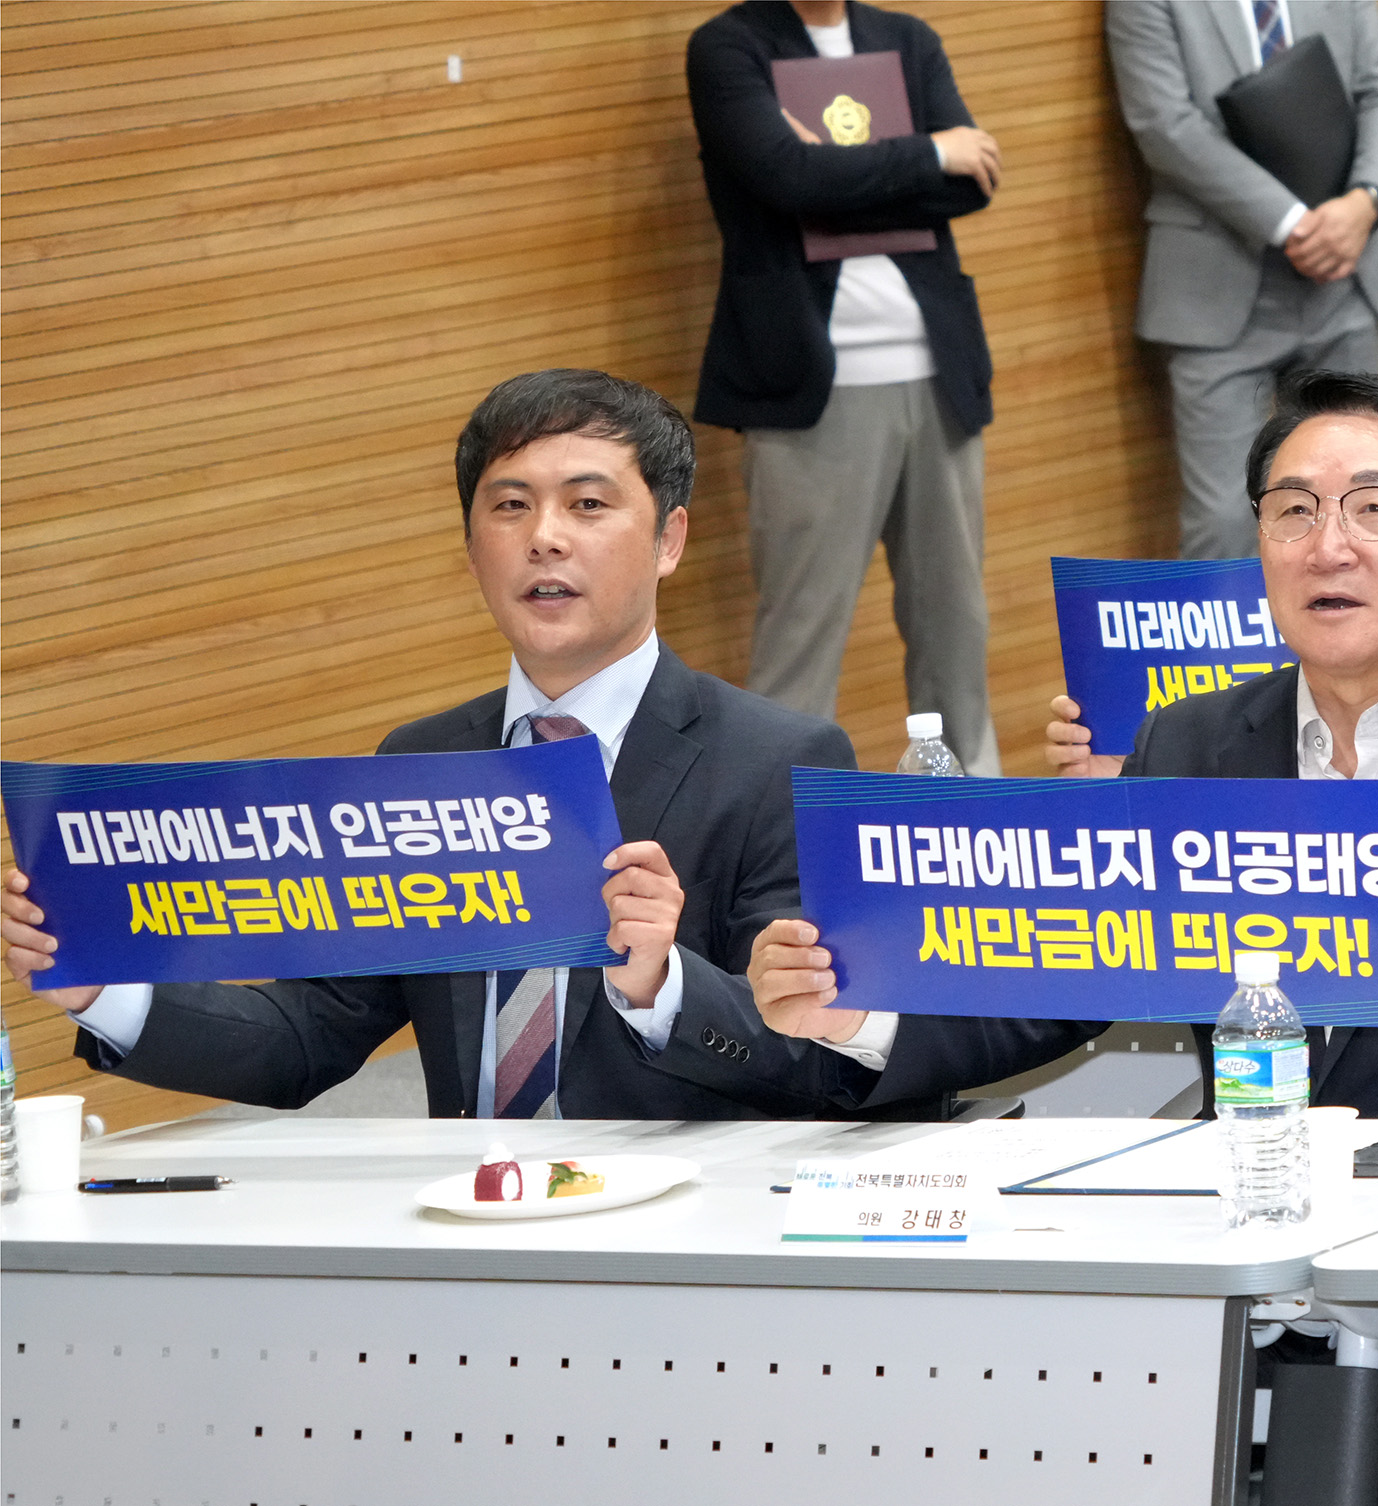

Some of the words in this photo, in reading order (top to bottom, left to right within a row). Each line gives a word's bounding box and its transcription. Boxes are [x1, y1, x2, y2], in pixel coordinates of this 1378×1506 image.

[1097, 597, 1286, 651] 미래에너
[56, 802, 324, 866] 미래에너지
[329, 793, 552, 859] 인공태양
[857, 824, 1157, 891] 미래에너지
[127, 876, 339, 936] 새만금에
[347, 870, 532, 929] 띄우자!
[918, 906, 1157, 971] 새만금에
[1171, 912, 1374, 977] 띄우자!
[855, 1173, 968, 1189] 전북특별자치도의회
[857, 1212, 883, 1227] 의원
